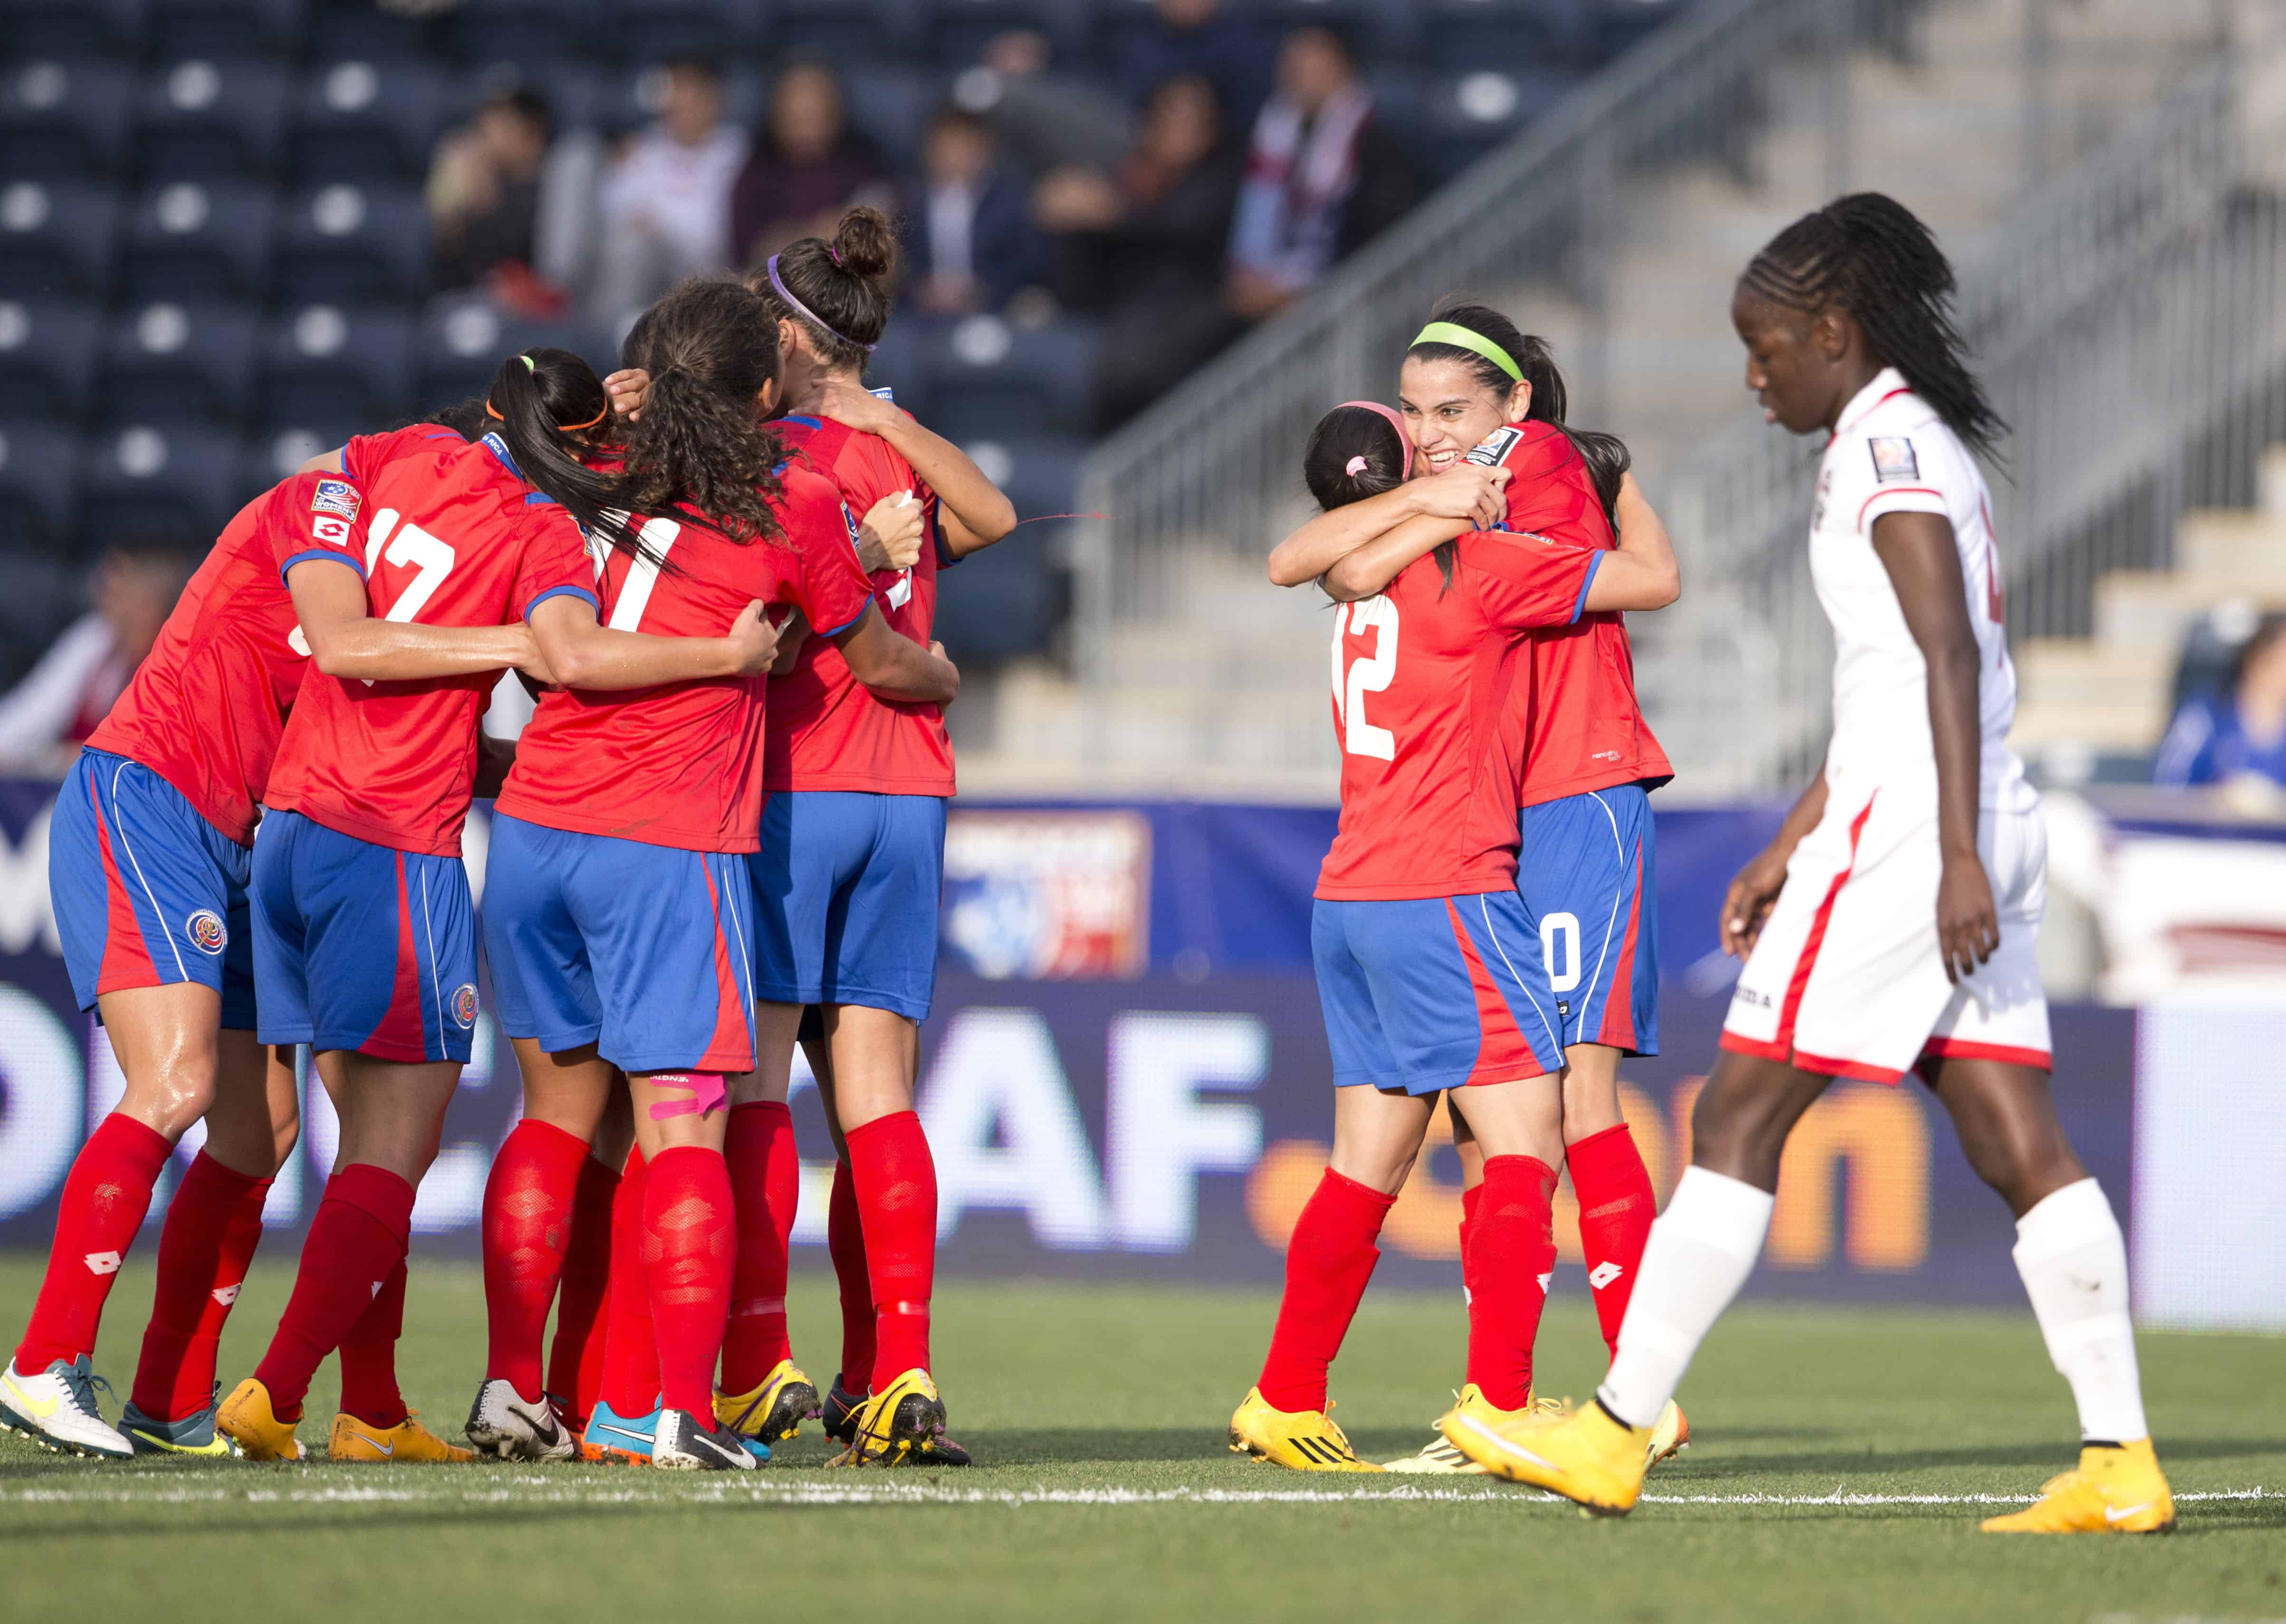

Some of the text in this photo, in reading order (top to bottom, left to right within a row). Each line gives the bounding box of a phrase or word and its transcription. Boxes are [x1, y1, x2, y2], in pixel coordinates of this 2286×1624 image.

[488, 439, 502, 456] RICA
[315, 501, 355, 519] WOMEN'S
[1331, 595, 1399, 762] 12
